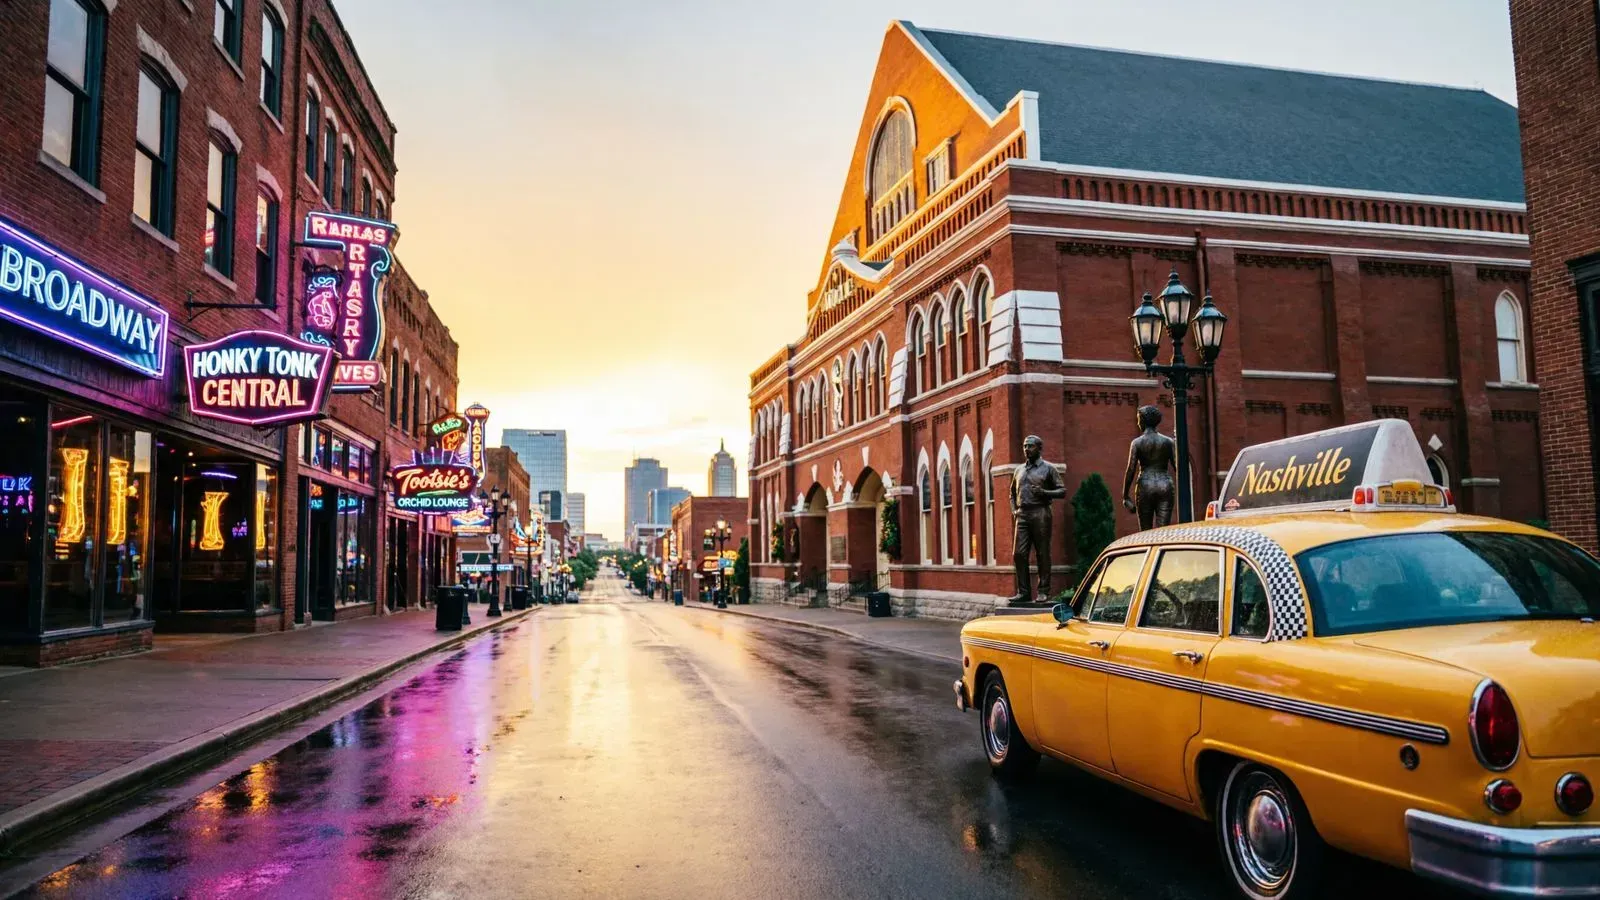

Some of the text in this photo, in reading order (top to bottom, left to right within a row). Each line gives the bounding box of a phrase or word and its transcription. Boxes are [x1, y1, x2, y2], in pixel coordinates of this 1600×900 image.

[0, 244, 161, 354] BROADWAY
[193, 346, 320, 379] HONKY TONK
[202, 379, 306, 407] CENTRAL
[396, 469, 470, 495] Tootsie's
[1239, 447, 1352, 496] Nashville
[397, 497, 468, 507] ORCHID LOUNGE
